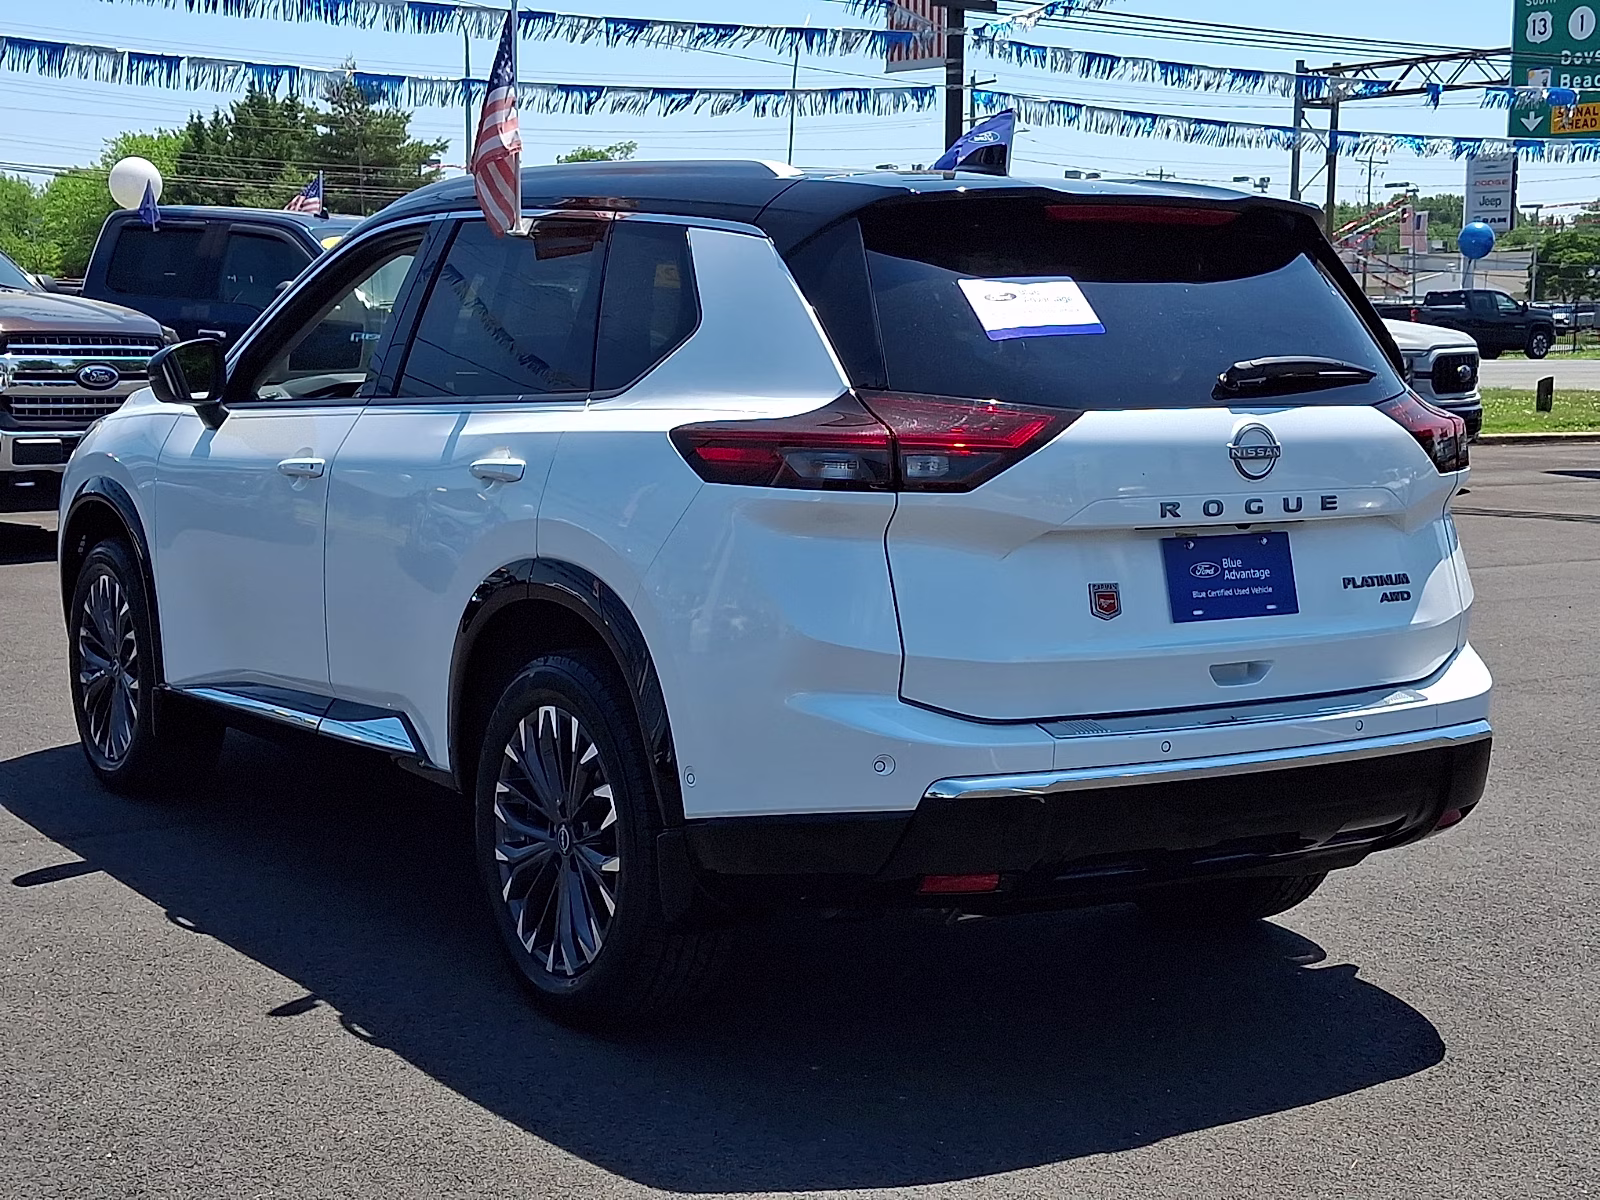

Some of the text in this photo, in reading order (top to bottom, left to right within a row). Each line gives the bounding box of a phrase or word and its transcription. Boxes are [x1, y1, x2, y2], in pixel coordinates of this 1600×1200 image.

[1532, 18, 1547, 36] 13
[1579, 14, 1585, 32] 1
[1479, 195, 1502, 208] Jeep
[90, 370, 111, 381] Ford
[1231, 447, 1280, 458] NISSAN
[1159, 495, 1339, 519] ROGUE
[1222, 557, 1243, 569] Blue
[1195, 564, 1216, 576] Ford
[1223, 567, 1271, 580] Advantage
[1342, 572, 1411, 589] PLATINUM
[1192, 585, 1273, 598] Blue Certified Used Vehicle
[1379, 590, 1412, 603] AWD
